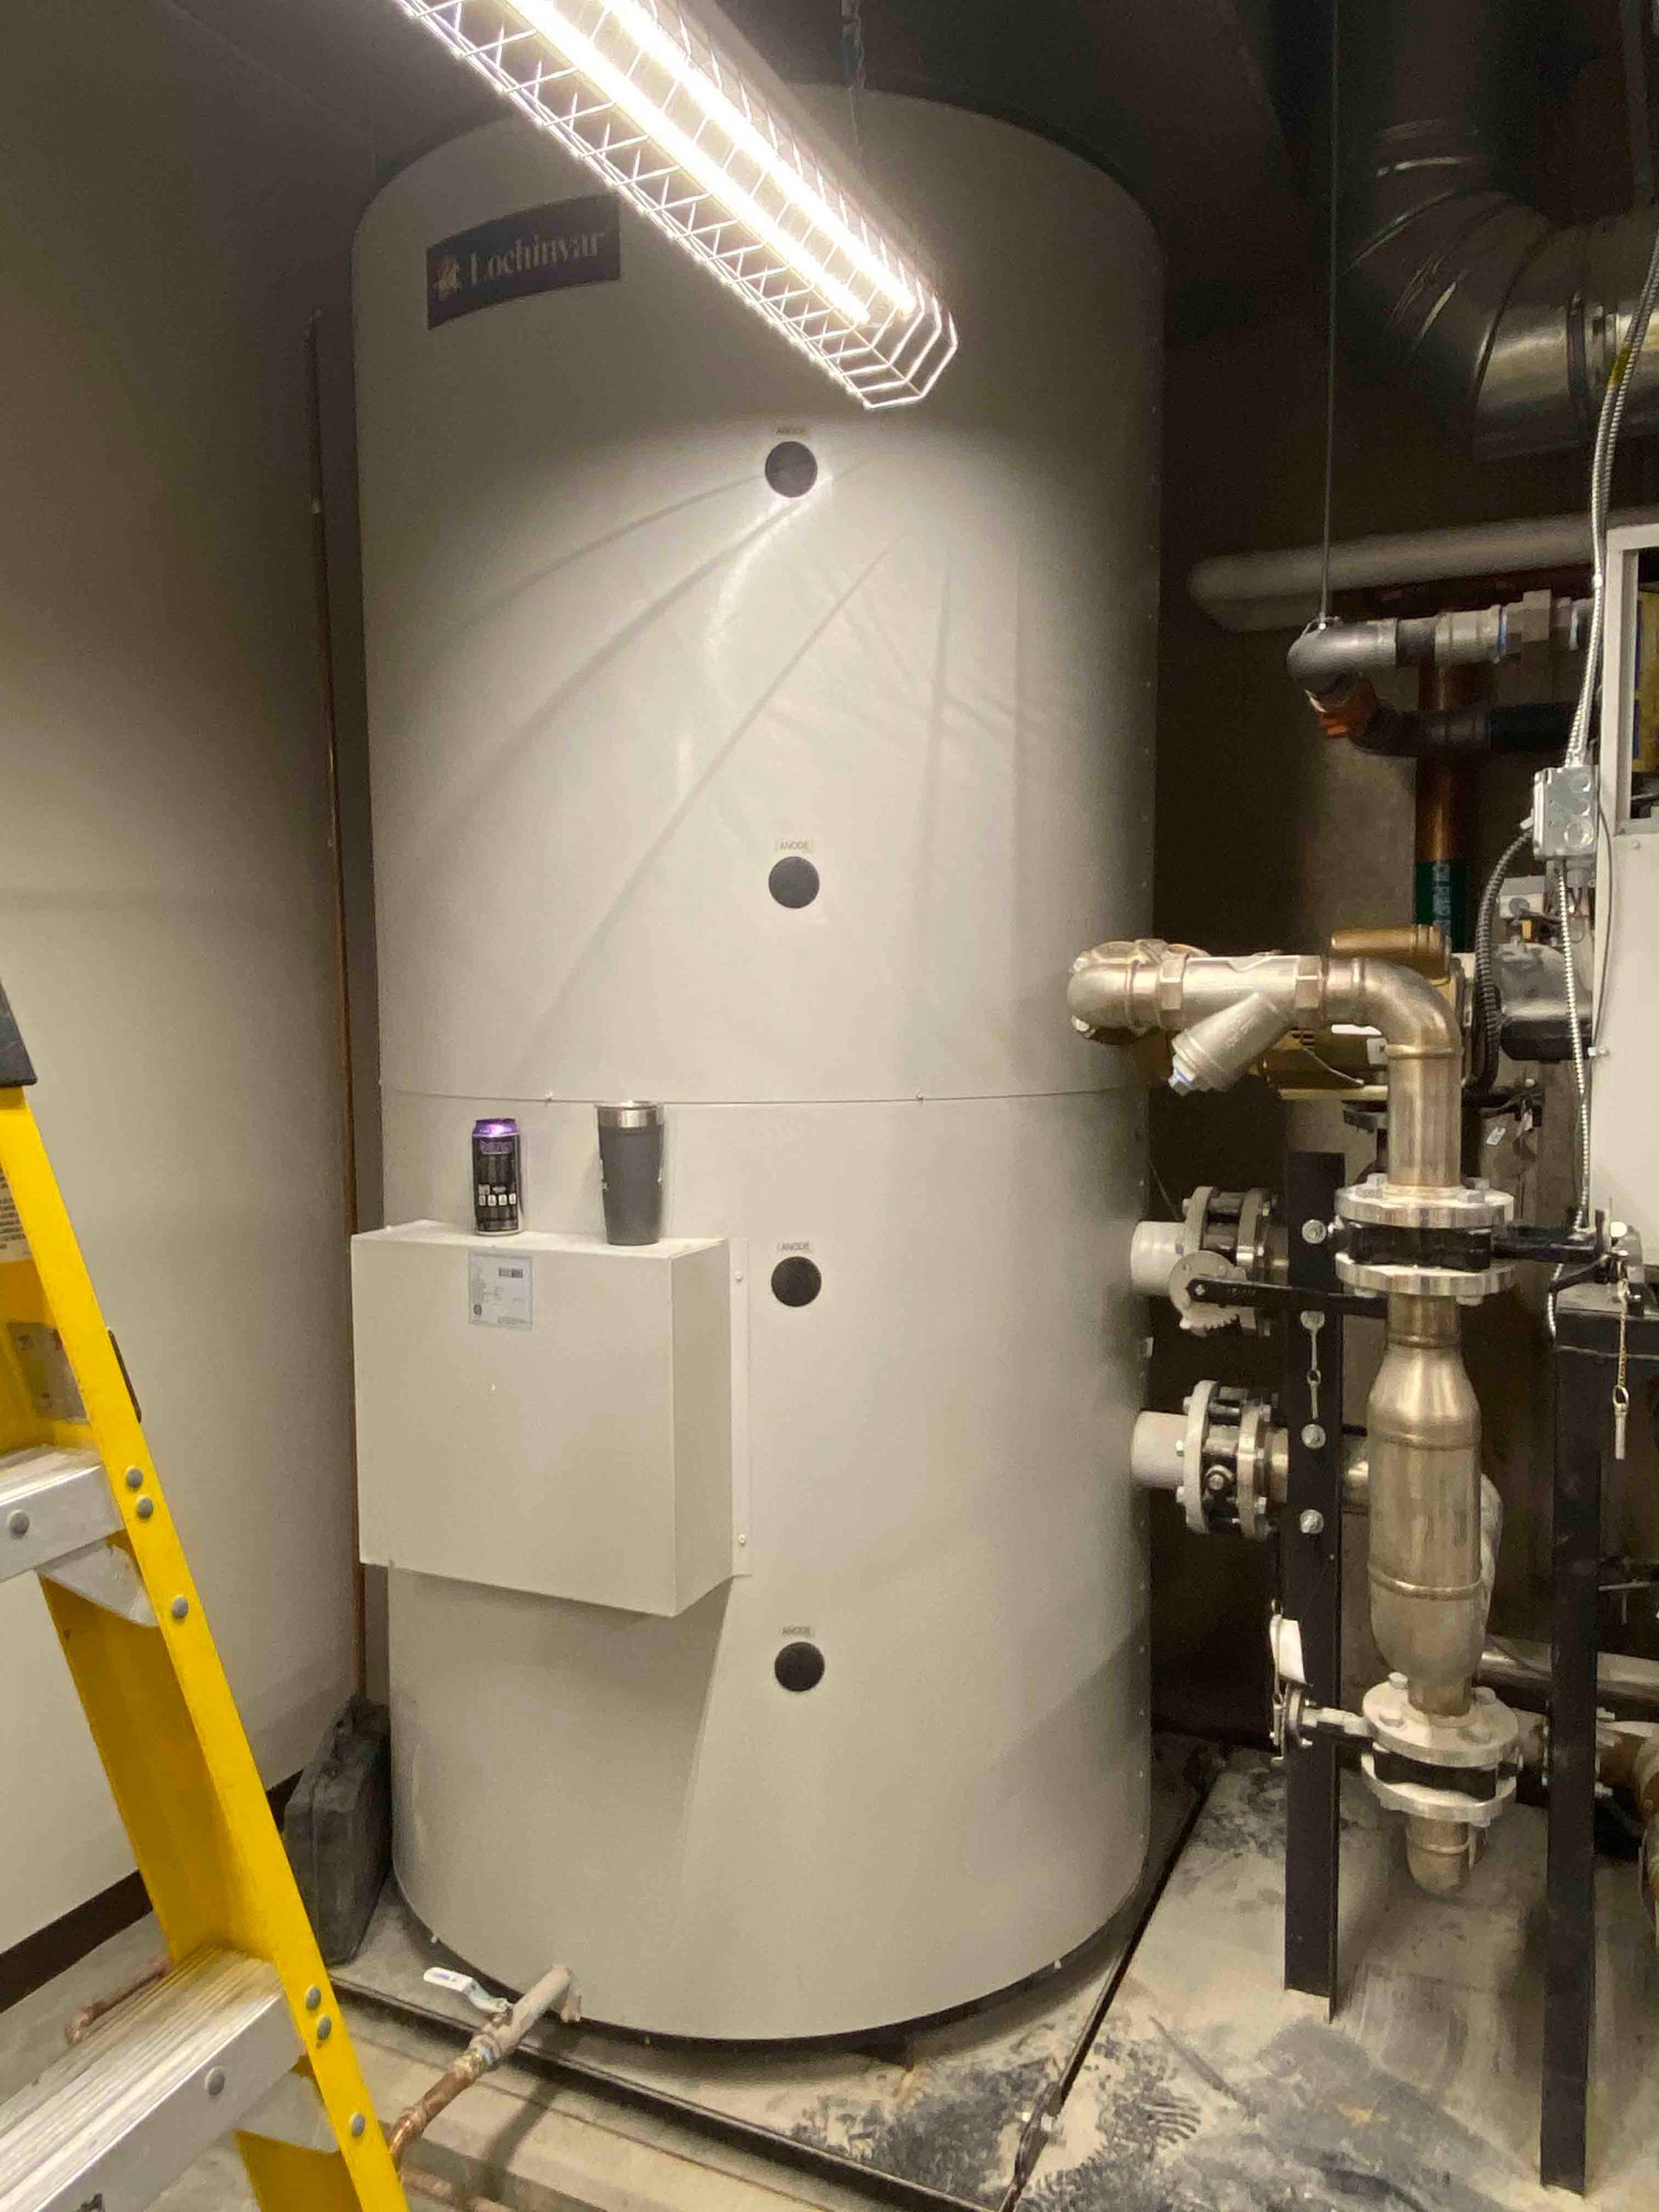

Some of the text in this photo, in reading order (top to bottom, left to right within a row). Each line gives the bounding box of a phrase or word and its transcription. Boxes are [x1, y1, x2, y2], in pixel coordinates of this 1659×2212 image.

[470, 231, 604, 286] Lochinvar
[779, 841, 810, 851] ANODE
[781, 1242, 810, 1252] ANODE
